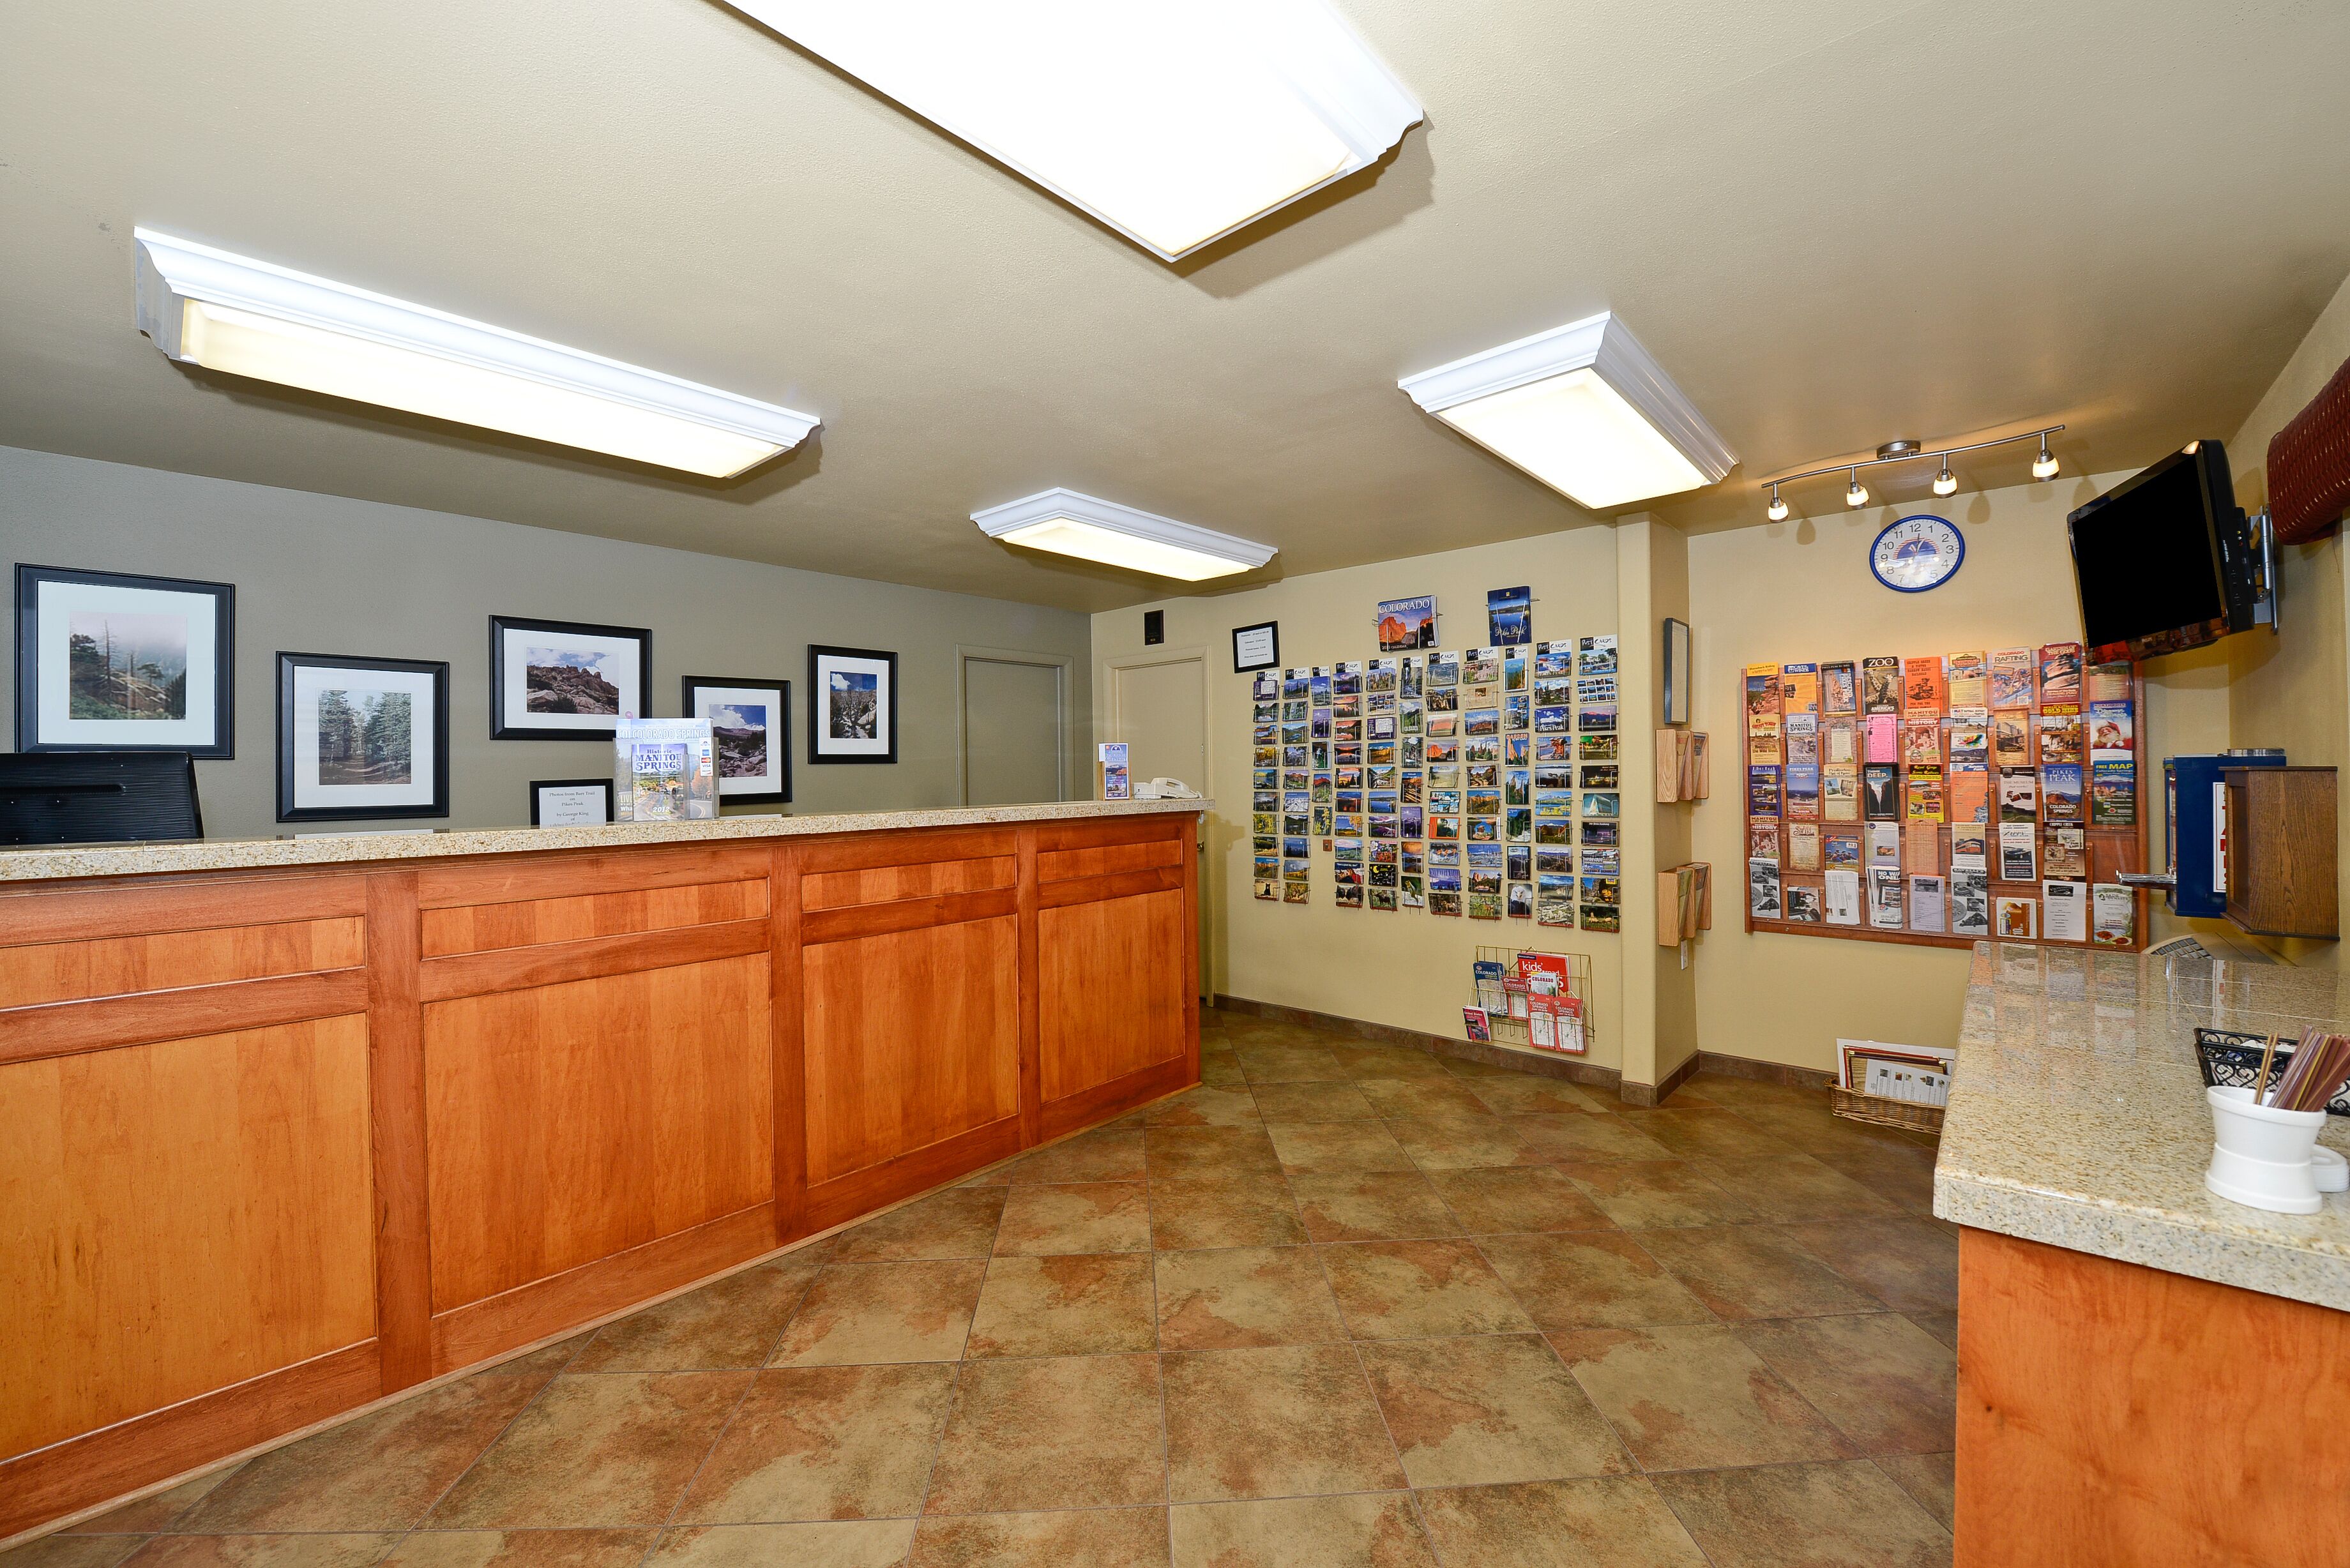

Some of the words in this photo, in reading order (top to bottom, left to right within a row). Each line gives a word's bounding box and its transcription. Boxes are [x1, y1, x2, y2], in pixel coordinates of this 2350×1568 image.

[1909, 524, 1921, 532] 12
[1942, 534, 1949, 542] 2
[1883, 541, 1894, 550] 10
[1946, 545, 1954, 554] 3
[1886, 566, 1894, 575] 8
[1930, 569, 1937, 578] 5
[1899, 575, 1904, 583] 7
[1379, 599, 1430, 613] COLORADO
[1511, 625, 1527, 635] Pek
[1869, 658, 1894, 667] ZOO
[633, 729, 674, 739] COLORADO
[676, 728, 710, 738] SPRINGS
[635, 761, 681, 771] SPRINGS
[1522, 960, 1543, 972] kids'
